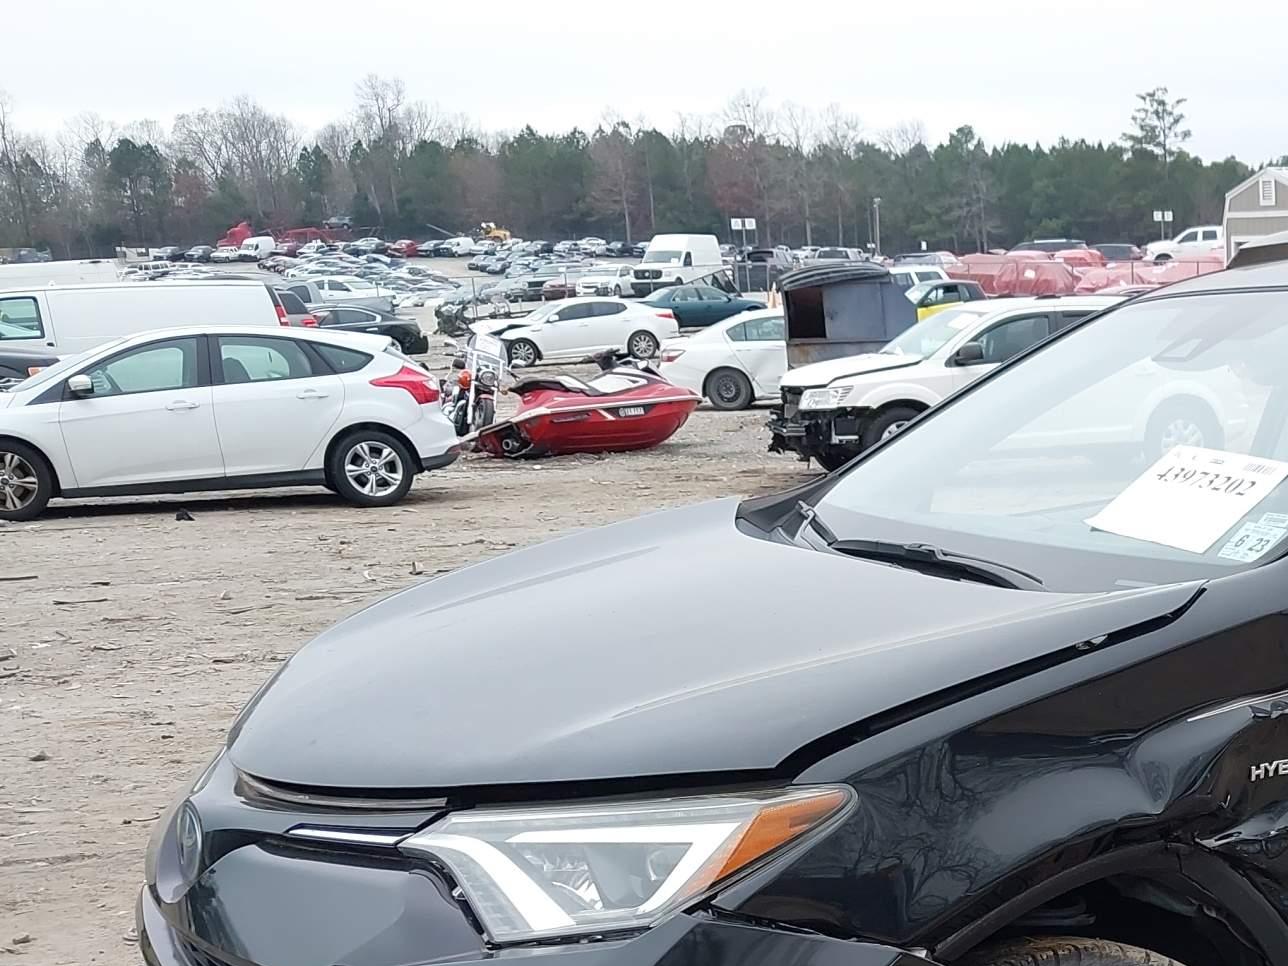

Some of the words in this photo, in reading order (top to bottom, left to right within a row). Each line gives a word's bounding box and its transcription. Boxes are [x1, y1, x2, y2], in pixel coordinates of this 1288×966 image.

[1156, 465, 1257, 496] 43973202
[1234, 534, 1250, 548] 6
[1247, 537, 1271, 553] 23
